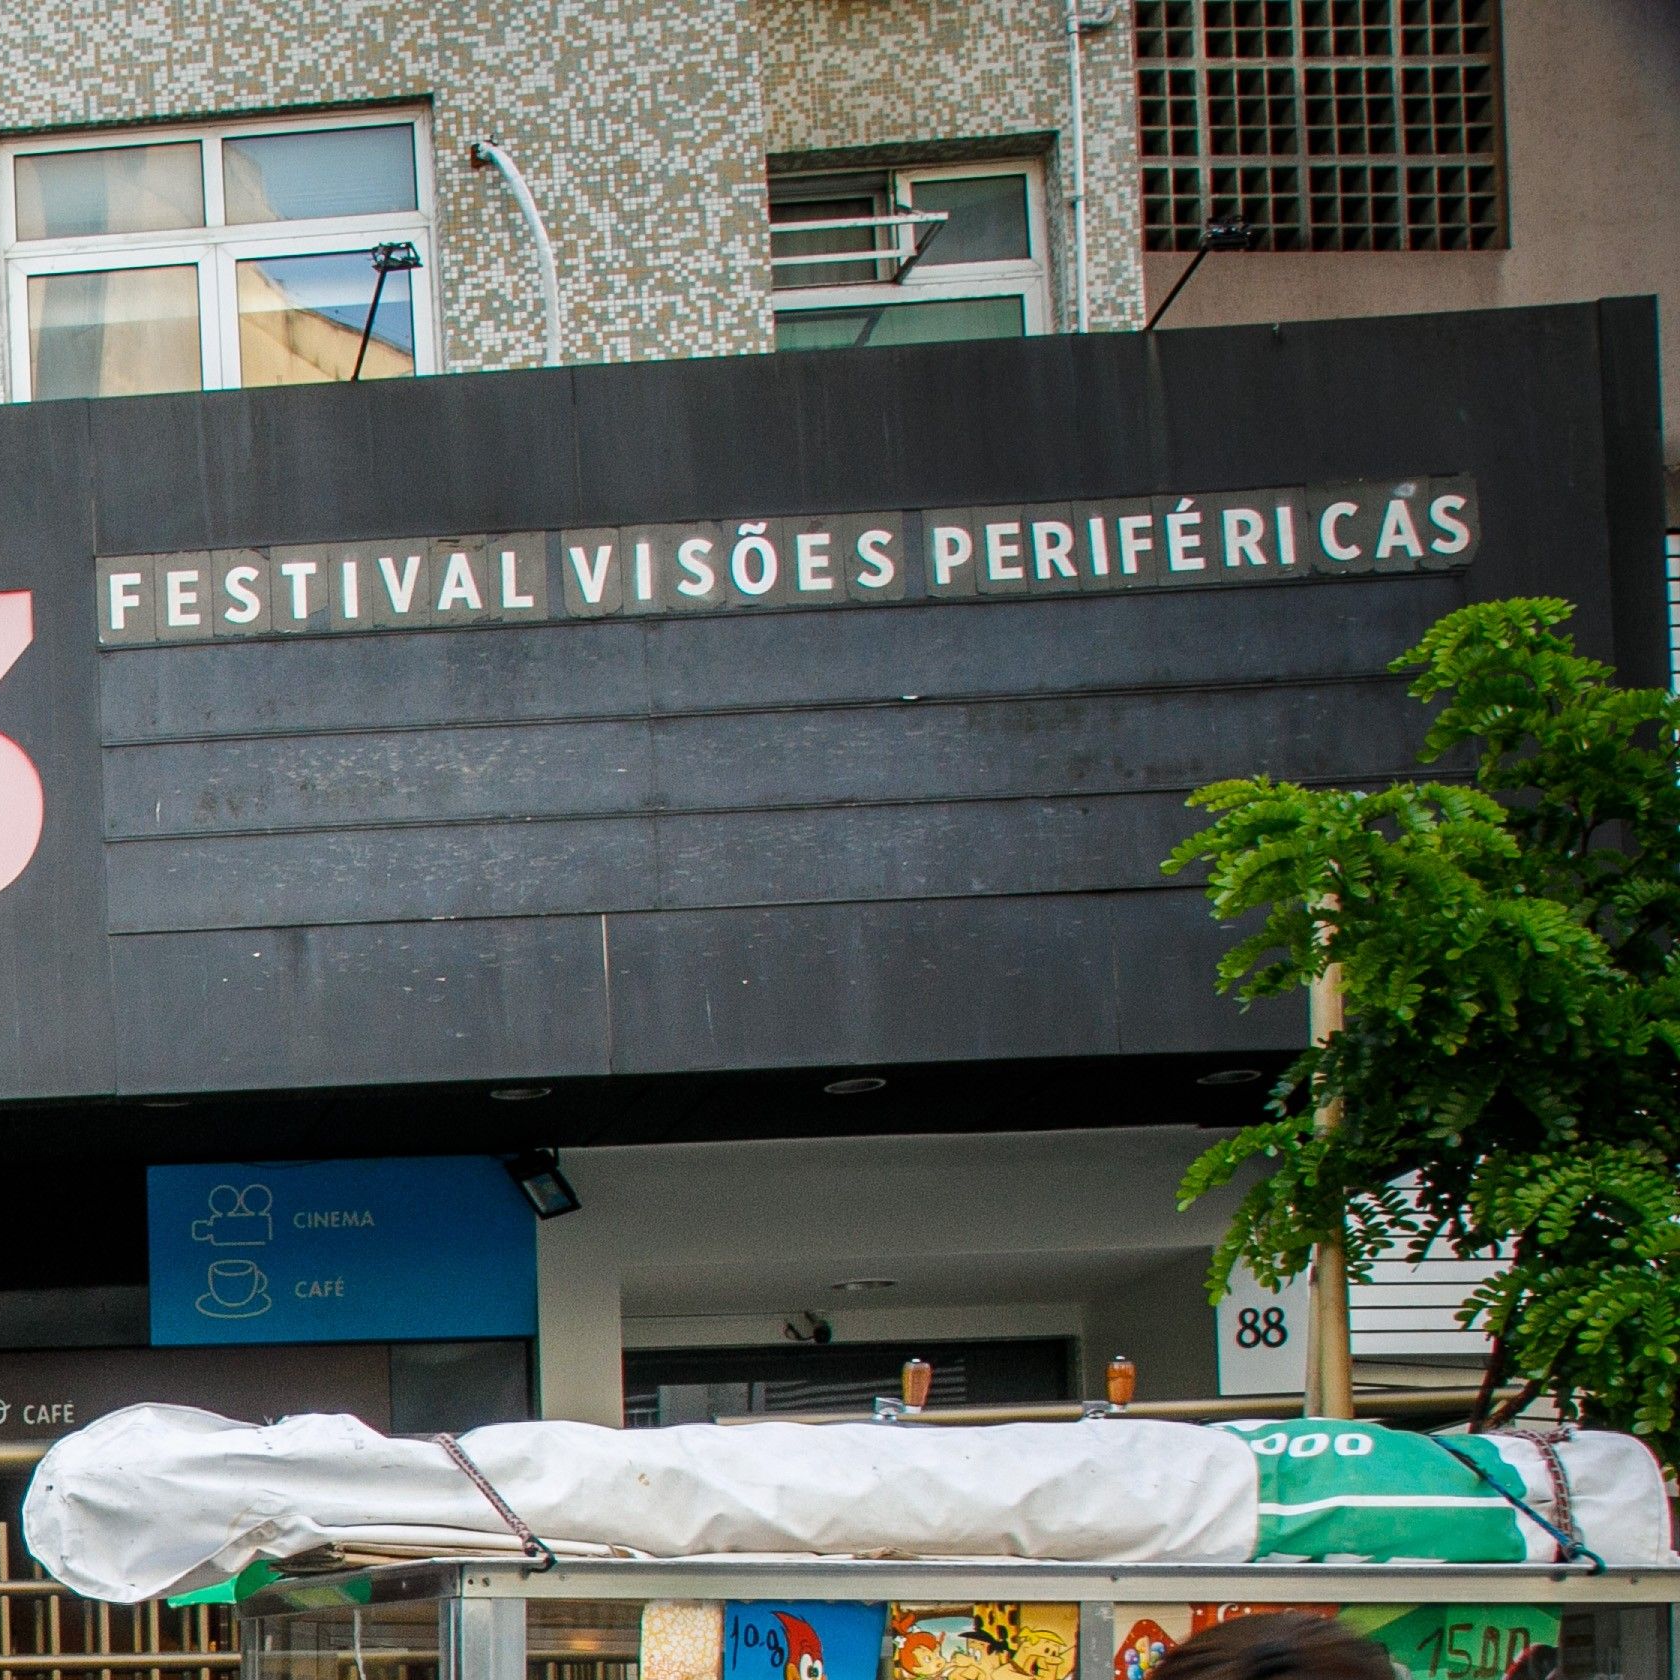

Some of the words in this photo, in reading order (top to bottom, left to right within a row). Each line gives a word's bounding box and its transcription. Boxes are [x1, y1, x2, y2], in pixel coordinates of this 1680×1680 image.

[108, 550, 535, 631] FESTIVAL
[568, 521, 895, 601] VISÕES
[932, 496, 1472, 585] PERIFÉRICAS
[293, 1210, 376, 1231] CINEMA
[294, 1274, 346, 1299] CAFÉ
[1235, 1306, 1289, 1349] 88
[23, 1399, 75, 1425] CAFÉ
